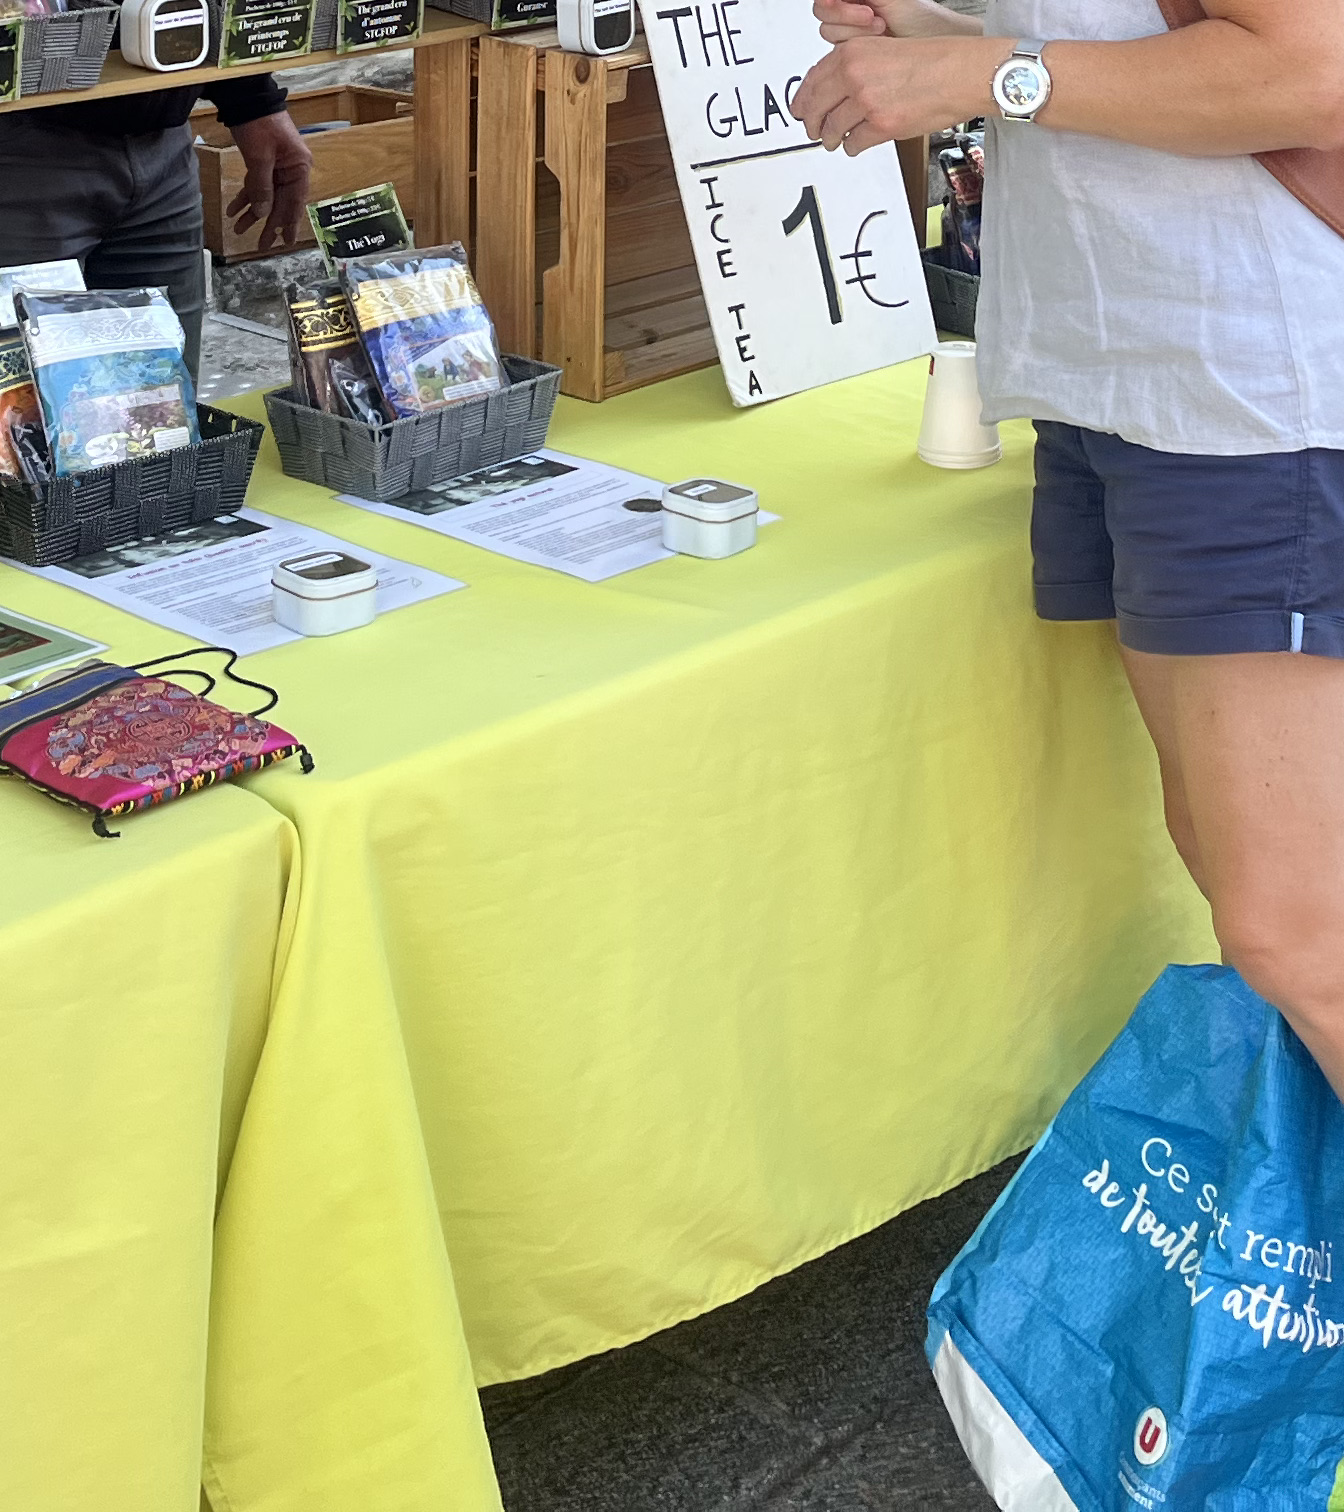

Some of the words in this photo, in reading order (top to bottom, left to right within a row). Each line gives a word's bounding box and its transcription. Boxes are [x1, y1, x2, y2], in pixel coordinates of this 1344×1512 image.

[705, 75, 802, 138] GLAC
[346, 238, 364, 251] Thé
[699, 175, 737, 279] ICE
[727, 303, 763, 397] TEA
[1082, 1158, 1126, 1208] de
[1141, 1138, 1190, 1194] Ce
[1239, 1227, 1333, 1288] rempli
[1139, 1416, 1162, 1454] U
